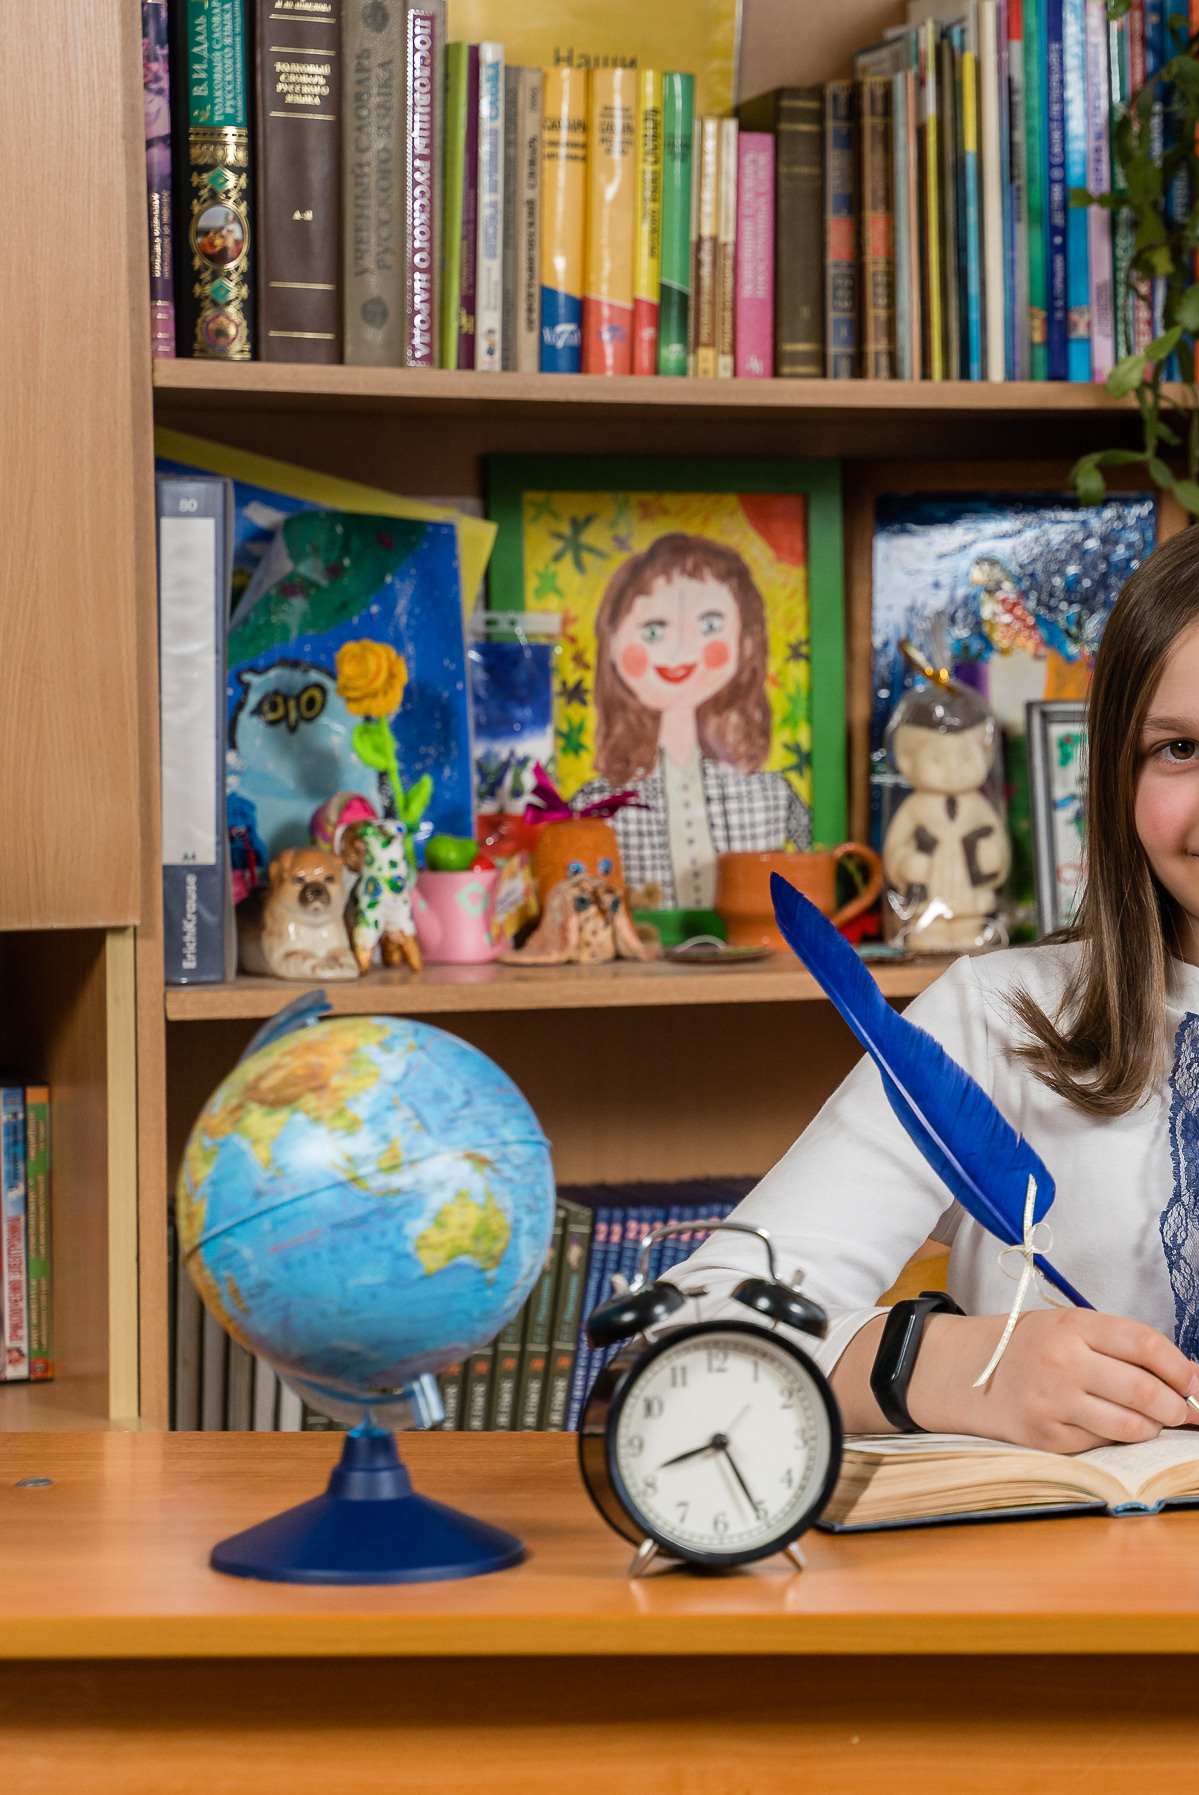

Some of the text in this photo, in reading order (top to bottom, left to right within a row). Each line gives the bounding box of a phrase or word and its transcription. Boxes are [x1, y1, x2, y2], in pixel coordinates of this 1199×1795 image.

[210, 0, 225, 122] ТОЛКОВЫЙ СЛОВАР
[221, 2, 235, 114] РУССКОГО ЯЗЫКА
[274, 62, 331, 75] ТОЛКОВЫЙ
[276, 82, 329, 96] РУССКОГО
[280, 73, 326, 86] СЛОВАРЬ
[355, 49, 372, 154] СЛОВАРЬ
[376, 58, 394, 272] РУССКОГО ЯЗЫКА
[412, 18, 432, 359] ПОСЛОВИЦЫ РУССКОГО НАРОДА
[181, 873, 197, 970] ErichKrause
[706, 1351, 728, 1373] 12
[751, 1360, 759, 1383] 1
[670, 1366, 687, 1388] 11
[643, 1398, 663, 1420] 10
[780, 1389, 794, 1410] 2
[627, 1435, 644, 1457] 9
[794, 1429, 808, 1450] 3
[643, 1475, 657, 1497] 8
[780, 1468, 793, 1489] 4
[676, 1502, 689, 1524] 7
[713, 1513, 728, 1534] 6
